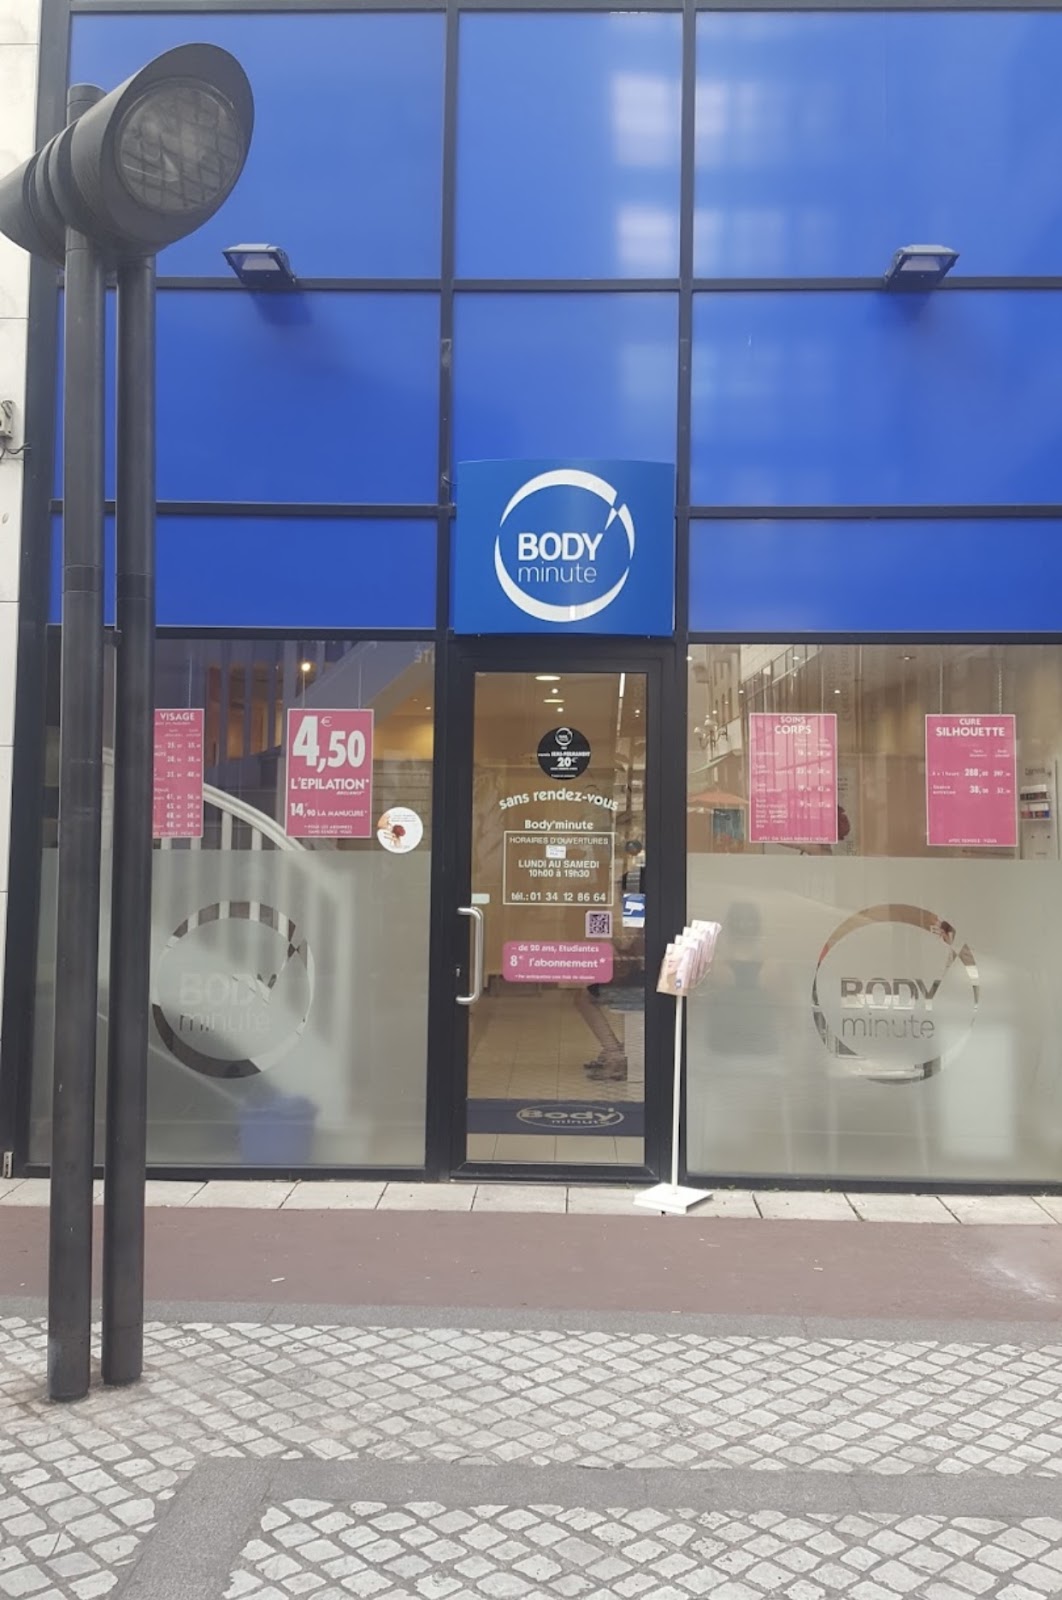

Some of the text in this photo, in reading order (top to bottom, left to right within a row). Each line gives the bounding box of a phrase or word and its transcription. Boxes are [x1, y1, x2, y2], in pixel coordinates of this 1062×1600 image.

[518, 532, 603, 561] BODY
[518, 561, 598, 583] minute
[160, 712, 195, 721] VISAGE
[959, 718, 981, 726] CURE
[775, 725, 812, 735] CORPS
[936, 727, 1006, 737] SILHOUETTE
[499, 788, 619, 811] sans rendez-vous
[510, 837, 548, 845] HORAIRES
[518, 860, 600, 869] LUNDI AU SAMEDI
[529, 869, 554, 878] 10h00
[565, 869, 591, 878] 19h30
[545, 893, 558, 902] 34
[563, 893, 573, 902] 12
[577, 893, 590, 902] 86
[593, 893, 606, 902] 64
[840, 977, 941, 1010] BODY
[842, 1012, 936, 1039] minute
